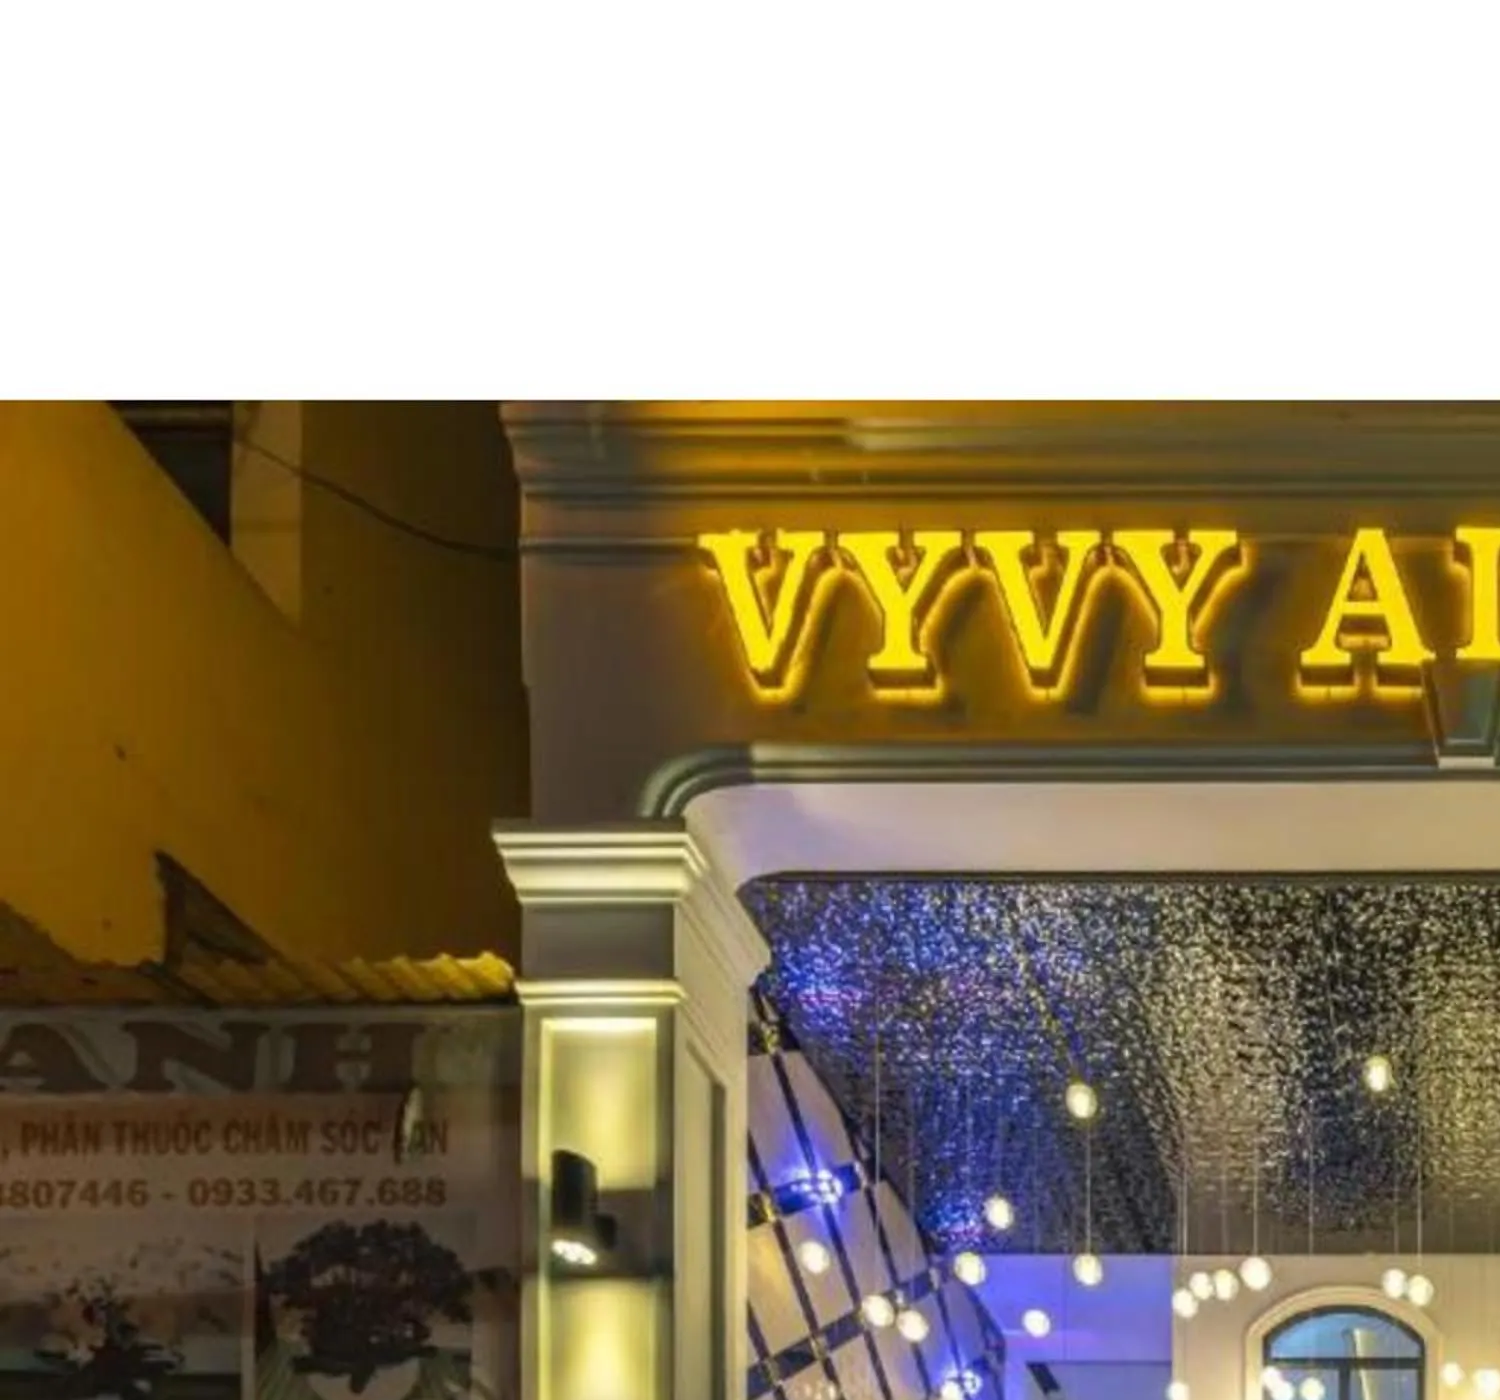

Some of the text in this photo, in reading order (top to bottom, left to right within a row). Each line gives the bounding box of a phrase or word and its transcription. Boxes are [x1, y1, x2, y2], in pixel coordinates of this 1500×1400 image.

[698, 529, 1243, 692] VYVY
[0, 1022, 428, 1092] ANH
[393, 1117, 448, 1156] AN
[0, 1178, 150, 1209] 807446
